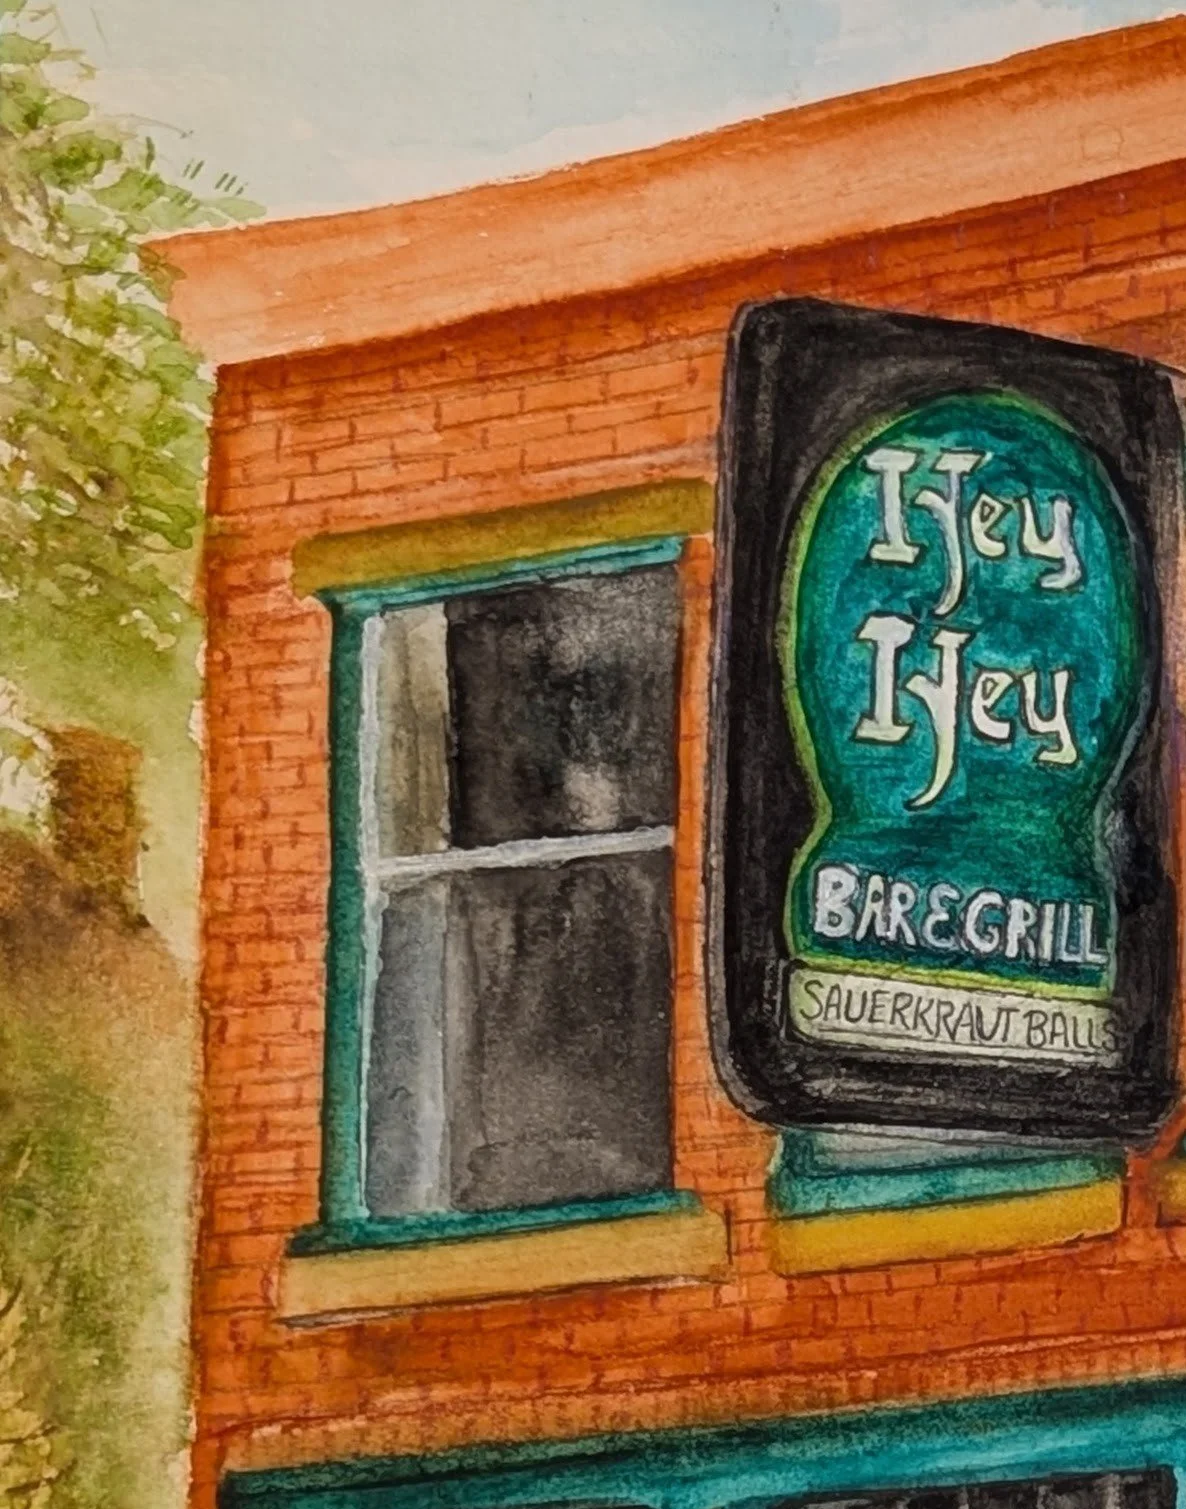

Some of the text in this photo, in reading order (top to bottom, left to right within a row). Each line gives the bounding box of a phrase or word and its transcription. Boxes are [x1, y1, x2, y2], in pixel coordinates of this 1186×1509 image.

[863, 447, 1083, 615] Hey
[851, 614, 1078, 811] Hey
[963, 889, 1110, 965] GRILL
[800, 979, 1119, 1051] SAUERKRAUT BALLS
